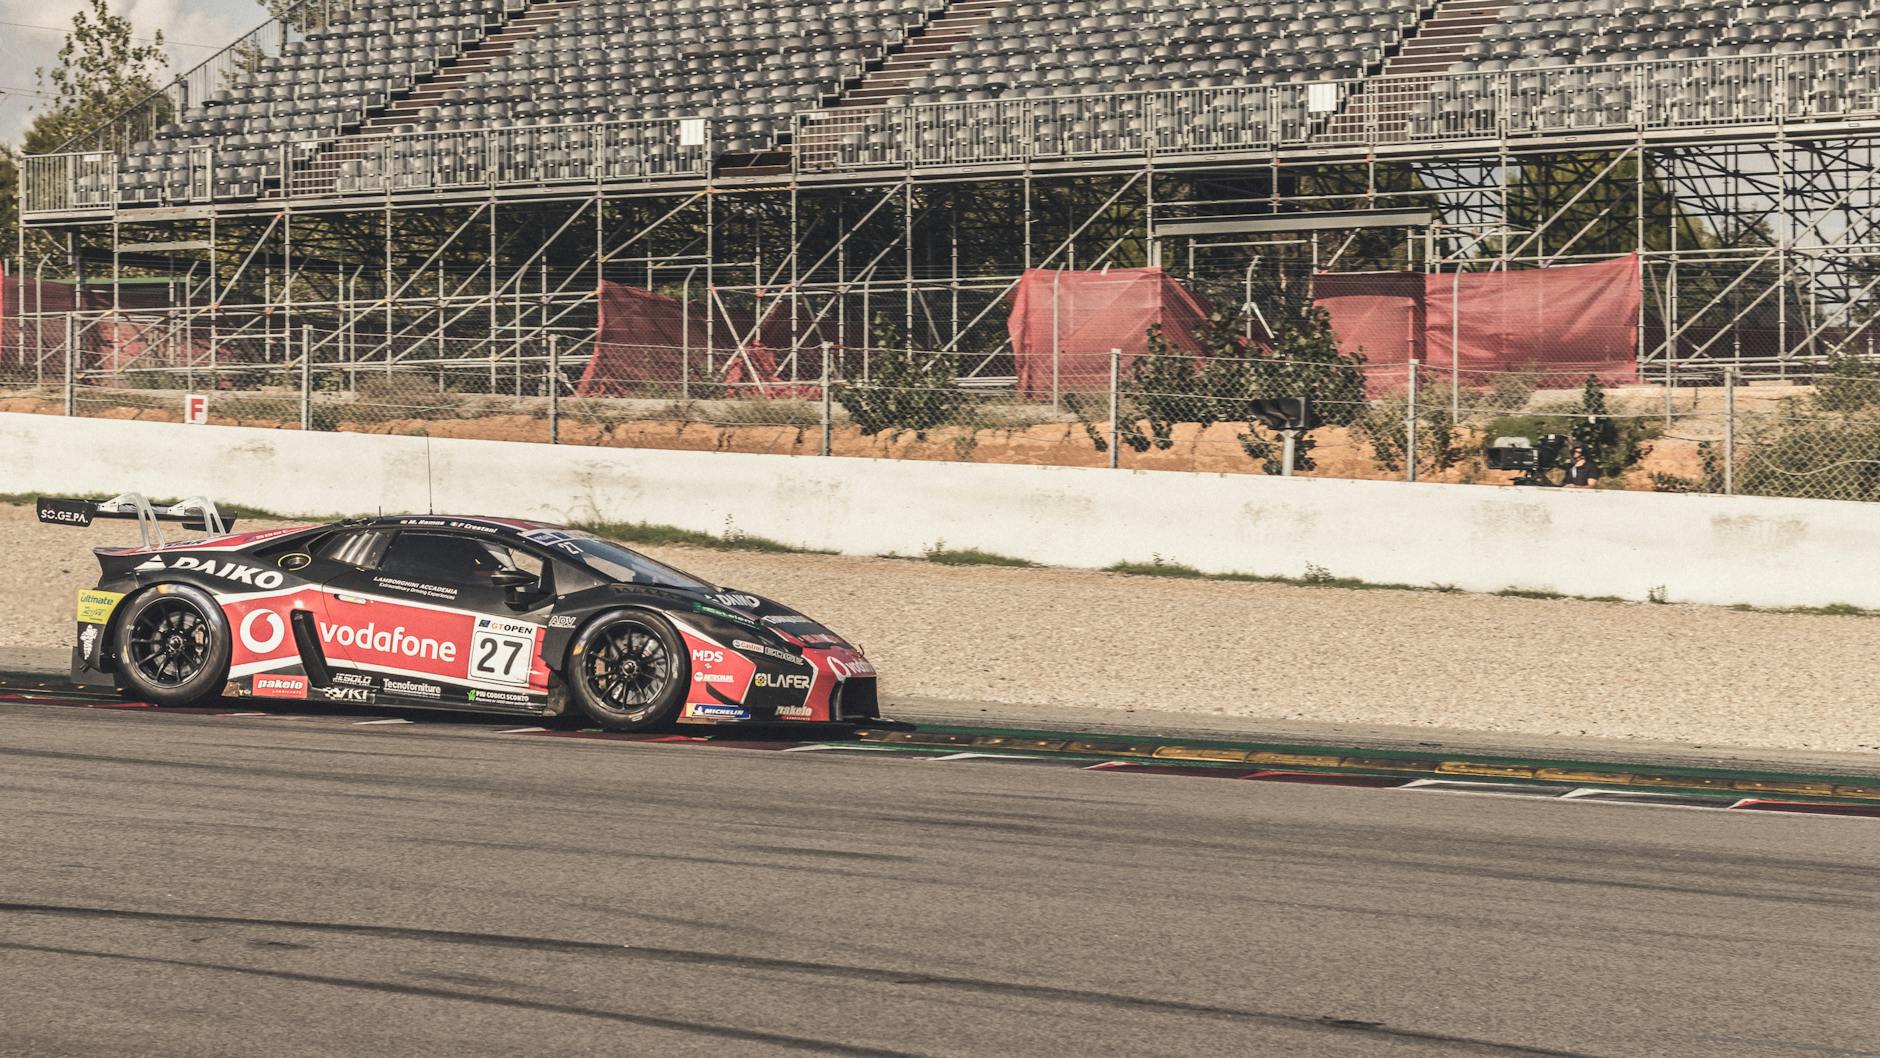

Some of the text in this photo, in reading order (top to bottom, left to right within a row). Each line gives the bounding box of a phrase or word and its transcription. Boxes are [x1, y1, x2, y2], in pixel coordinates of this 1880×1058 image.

[191, 398, 204, 421] F
[168, 556, 284, 590] DAIKO
[373, 576, 458, 595] LAMBORGHINI ACCADEMIA
[80, 594, 114, 606] ultimate
[319, 621, 457, 663] vodafone
[477, 637, 523, 676] 27
[692, 649, 724, 663] MDS
[257, 679, 304, 690] pakelo
[383, 678, 442, 694] Tecnoforniture
[767, 675, 810, 689] LAFER
[704, 708, 744, 717] MICHELIN
